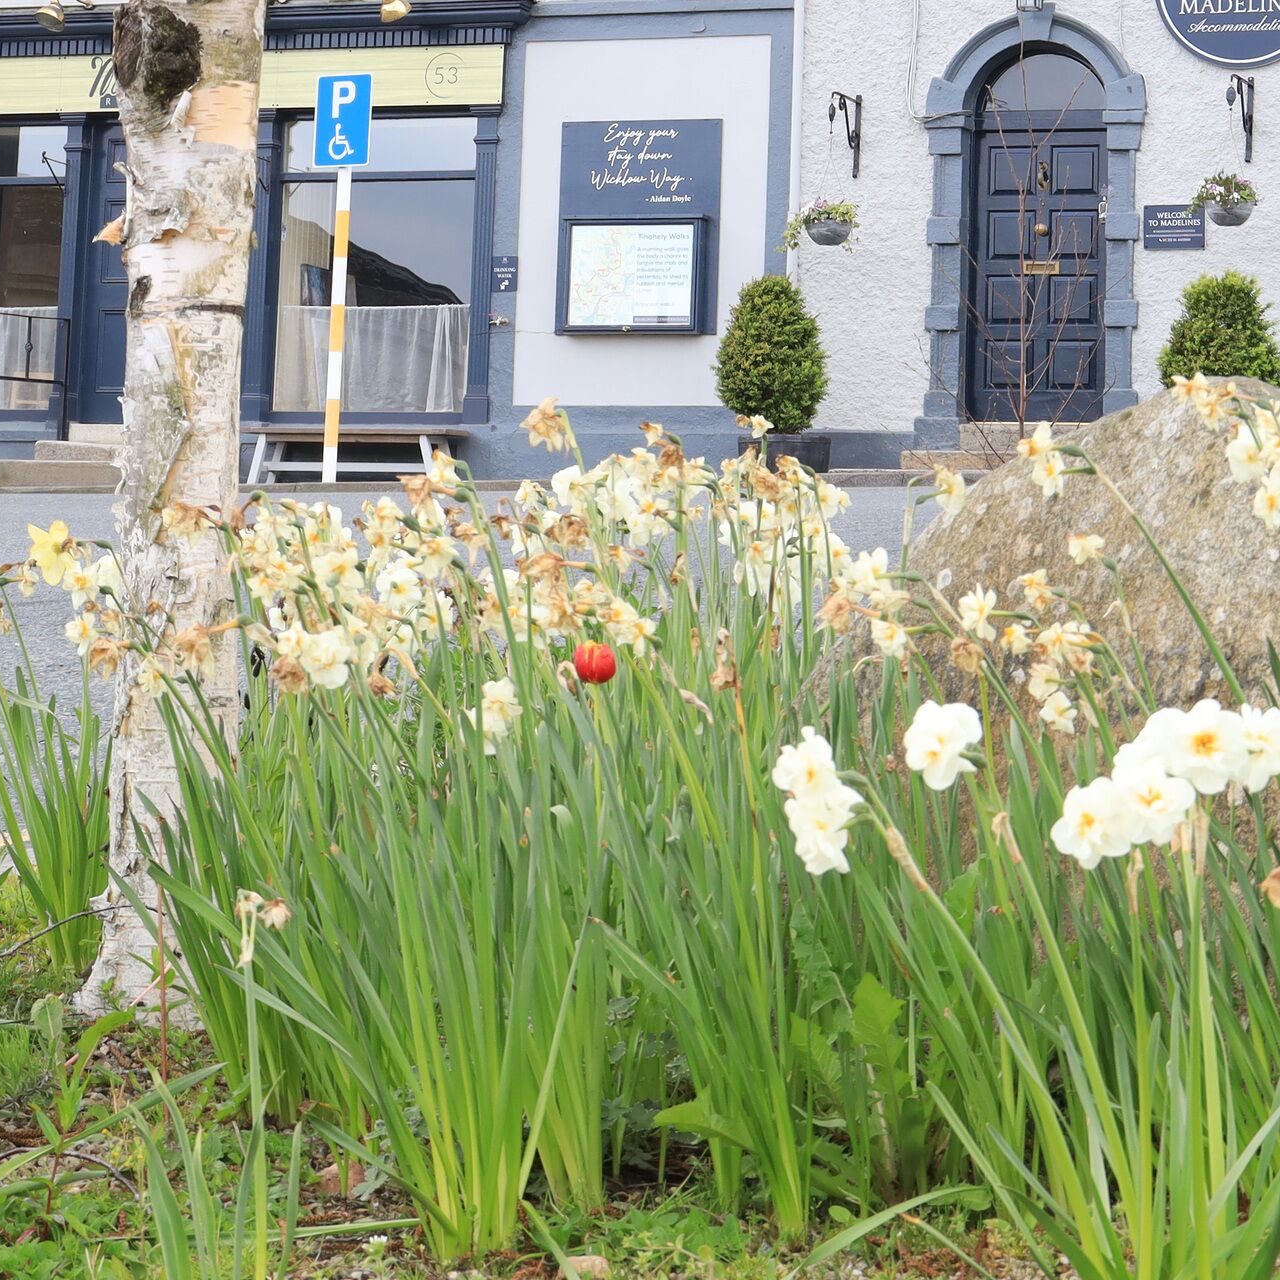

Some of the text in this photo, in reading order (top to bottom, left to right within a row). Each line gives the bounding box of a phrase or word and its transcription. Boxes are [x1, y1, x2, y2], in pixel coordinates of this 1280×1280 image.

[434, 67, 458, 84] 53
[332, 80, 356, 118] P
[604, 123, 679, 146] Enjoy your
[607, 146, 673, 169] stay down
[591, 168, 647, 190] Wicklow
[650, 195, 670, 203] Aidan
[672, 195, 691, 203] Doyle
